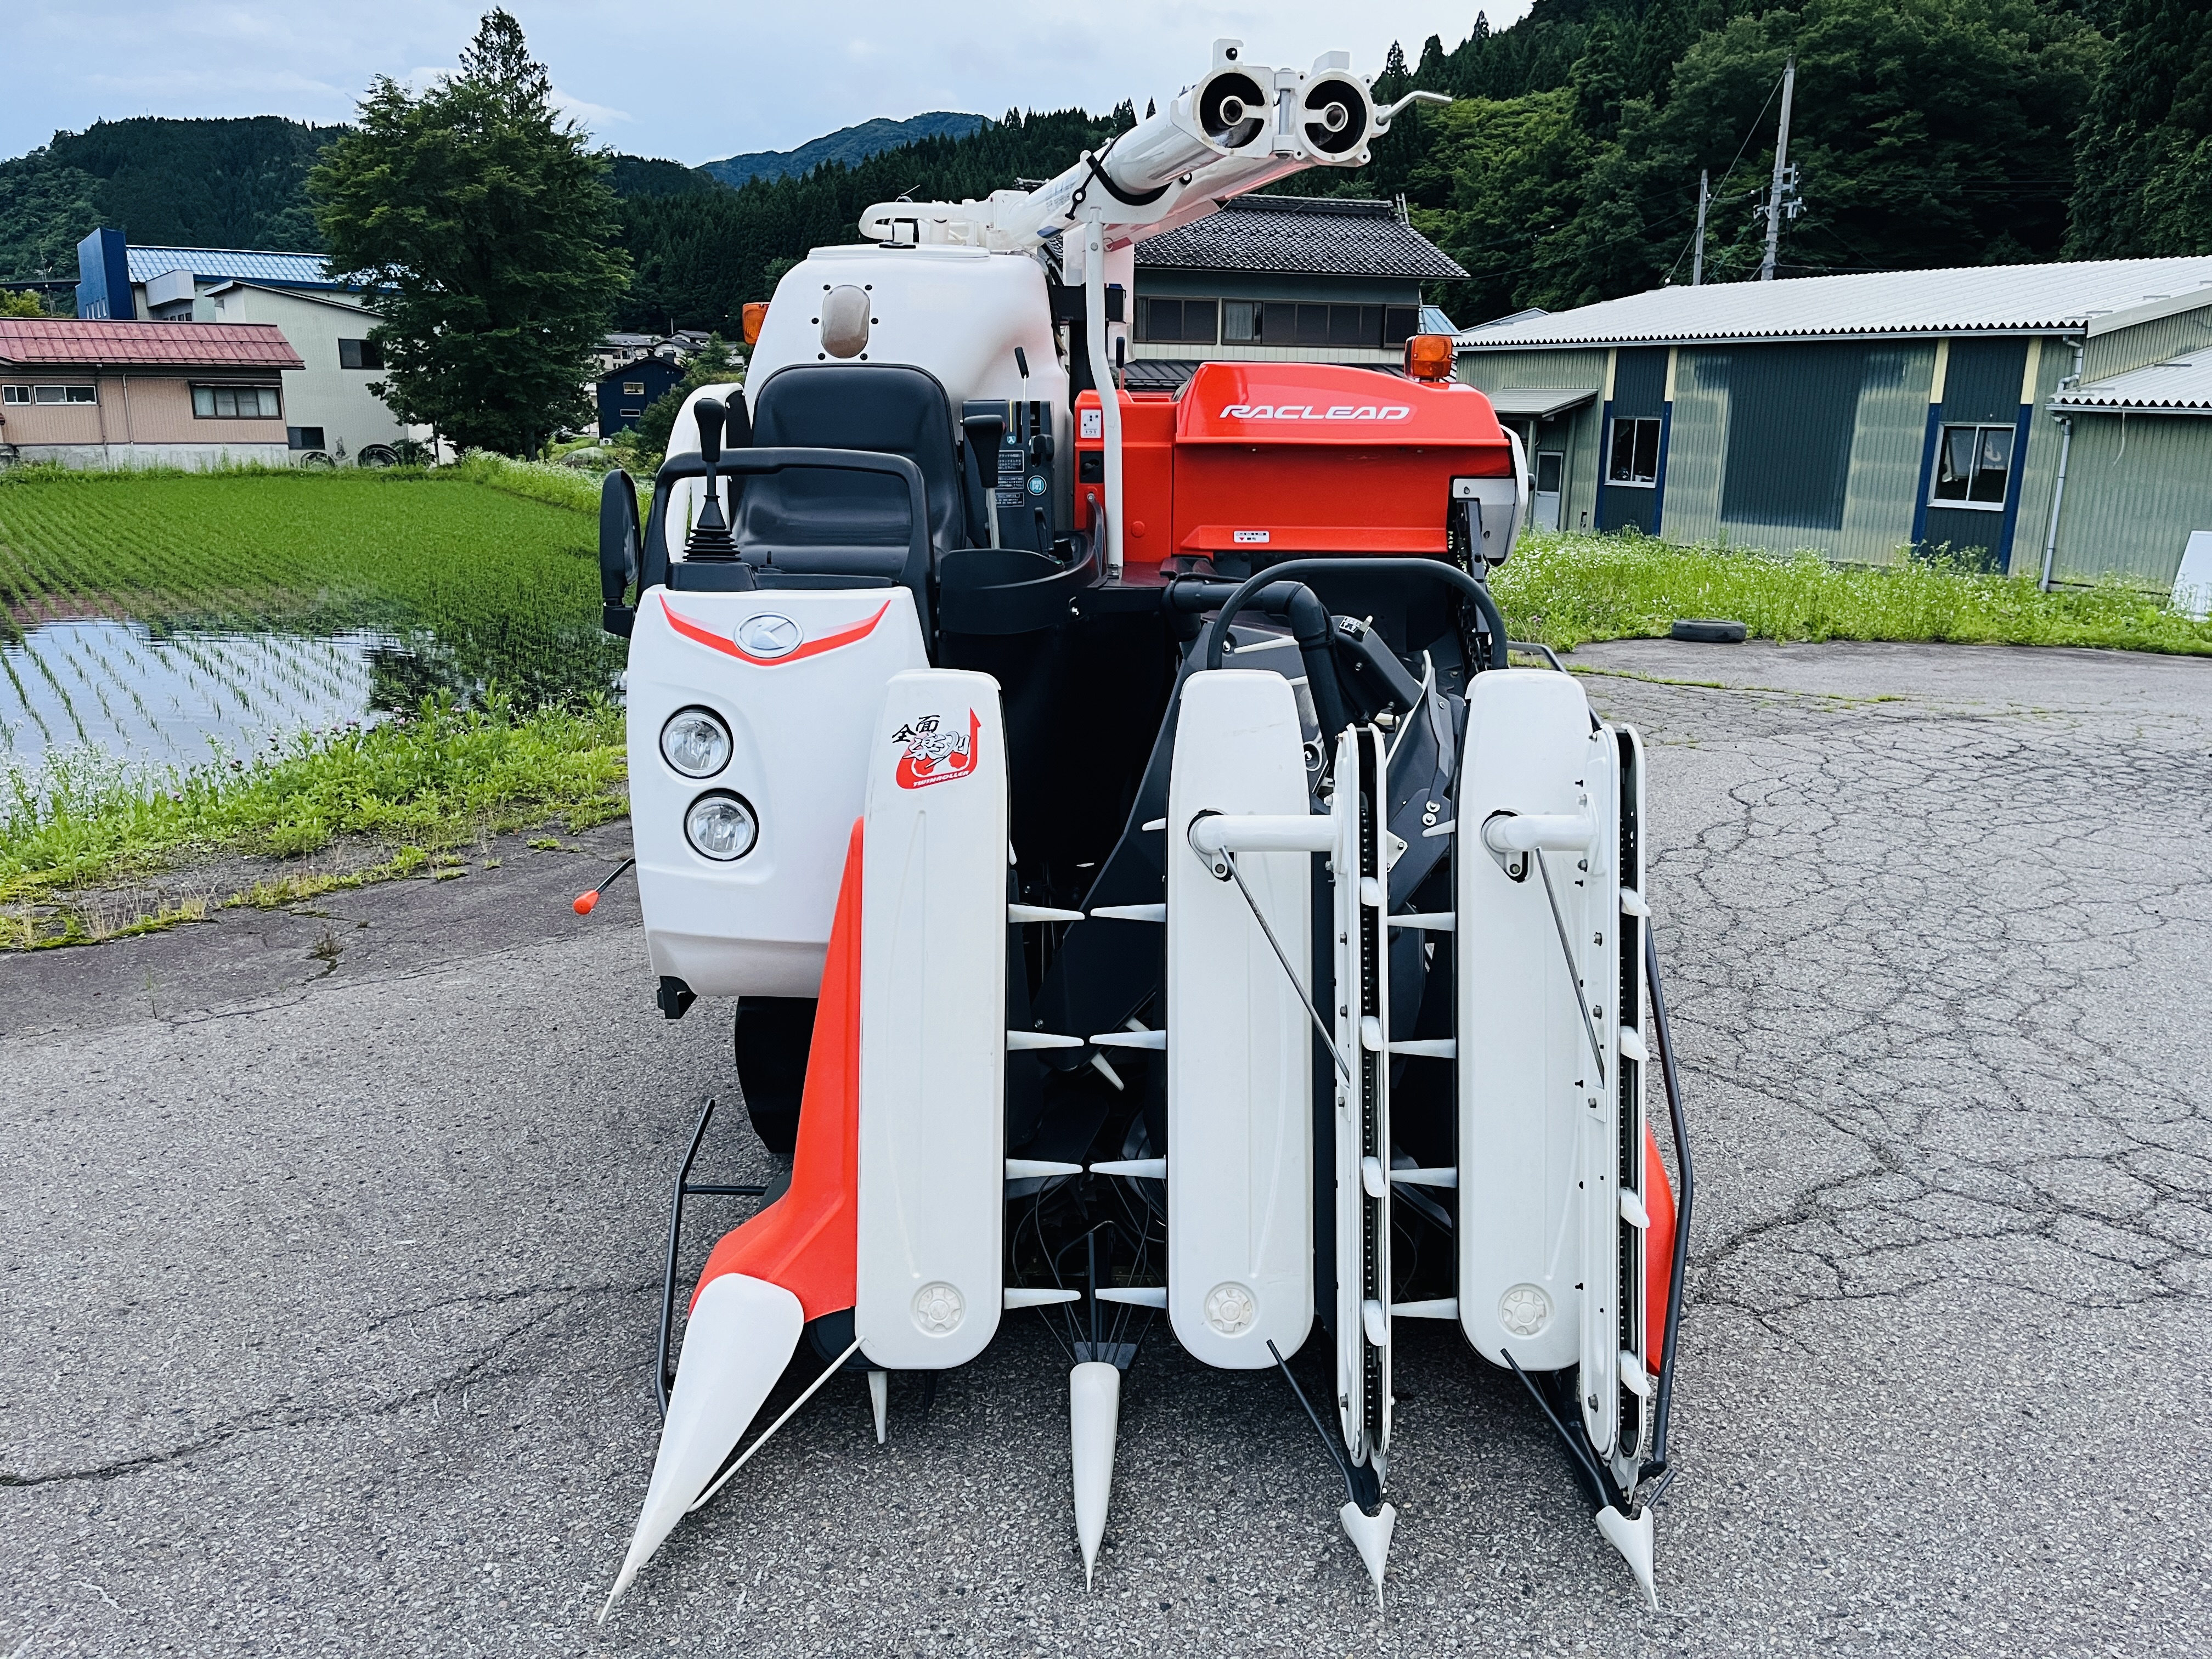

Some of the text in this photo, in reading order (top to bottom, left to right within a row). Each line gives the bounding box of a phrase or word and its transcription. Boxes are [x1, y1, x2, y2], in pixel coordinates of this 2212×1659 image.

[1219, 405, 1410, 420] RACLEAD
[891, 715, 940, 743] 全面
[913, 770, 970, 787] TWINROLLER
